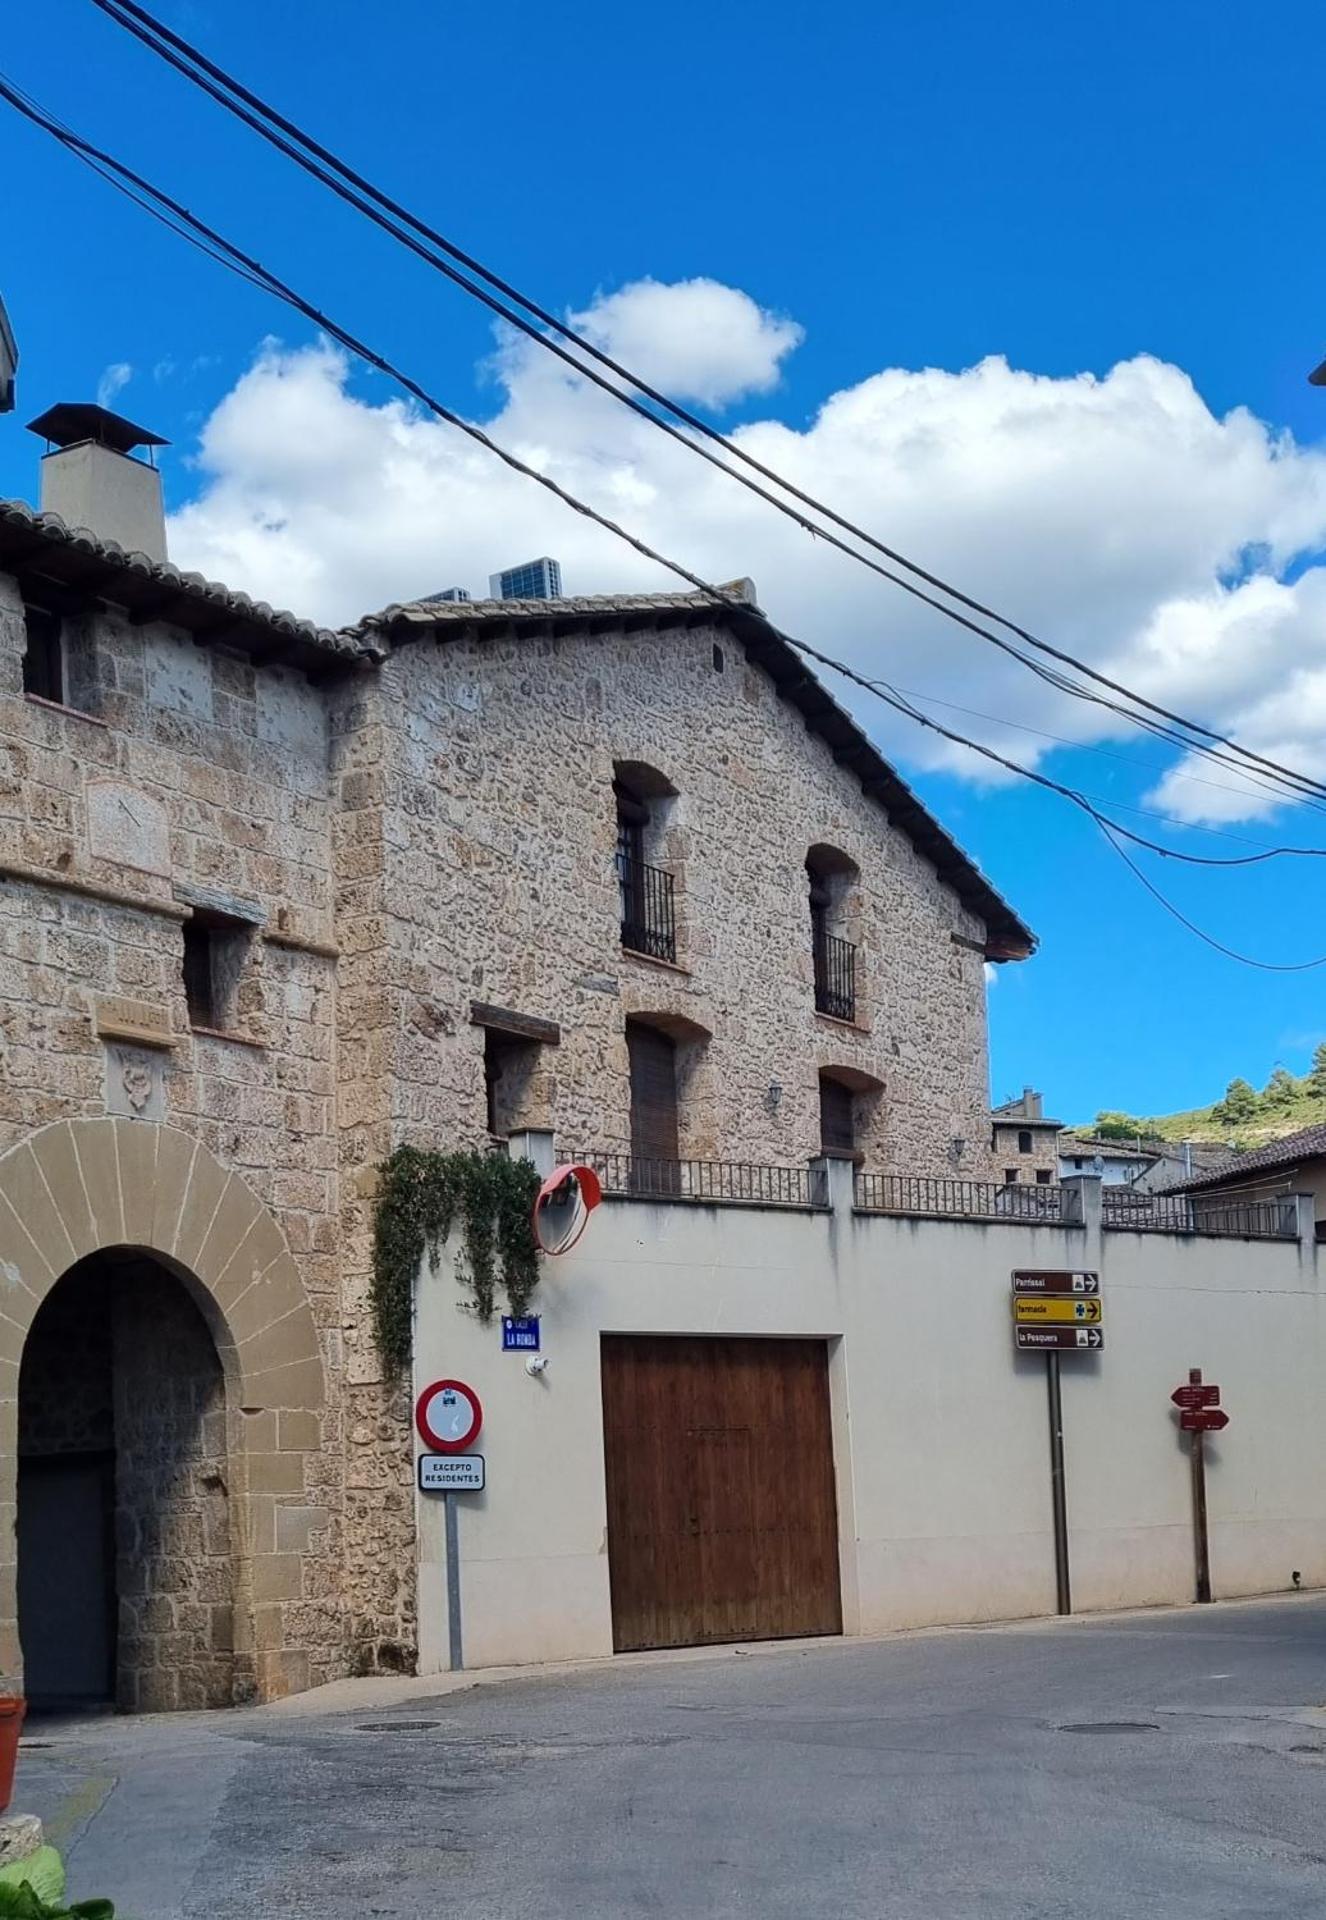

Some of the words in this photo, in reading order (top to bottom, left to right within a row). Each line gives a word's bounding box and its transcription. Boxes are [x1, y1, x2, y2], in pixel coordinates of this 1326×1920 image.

[506, 1333, 515, 1346] LA
[516, 1333, 536, 1346] RONDA
[433, 1464, 472, 1472] EXCEPTO
[425, 1475, 480, 1483] RESIDENTES
